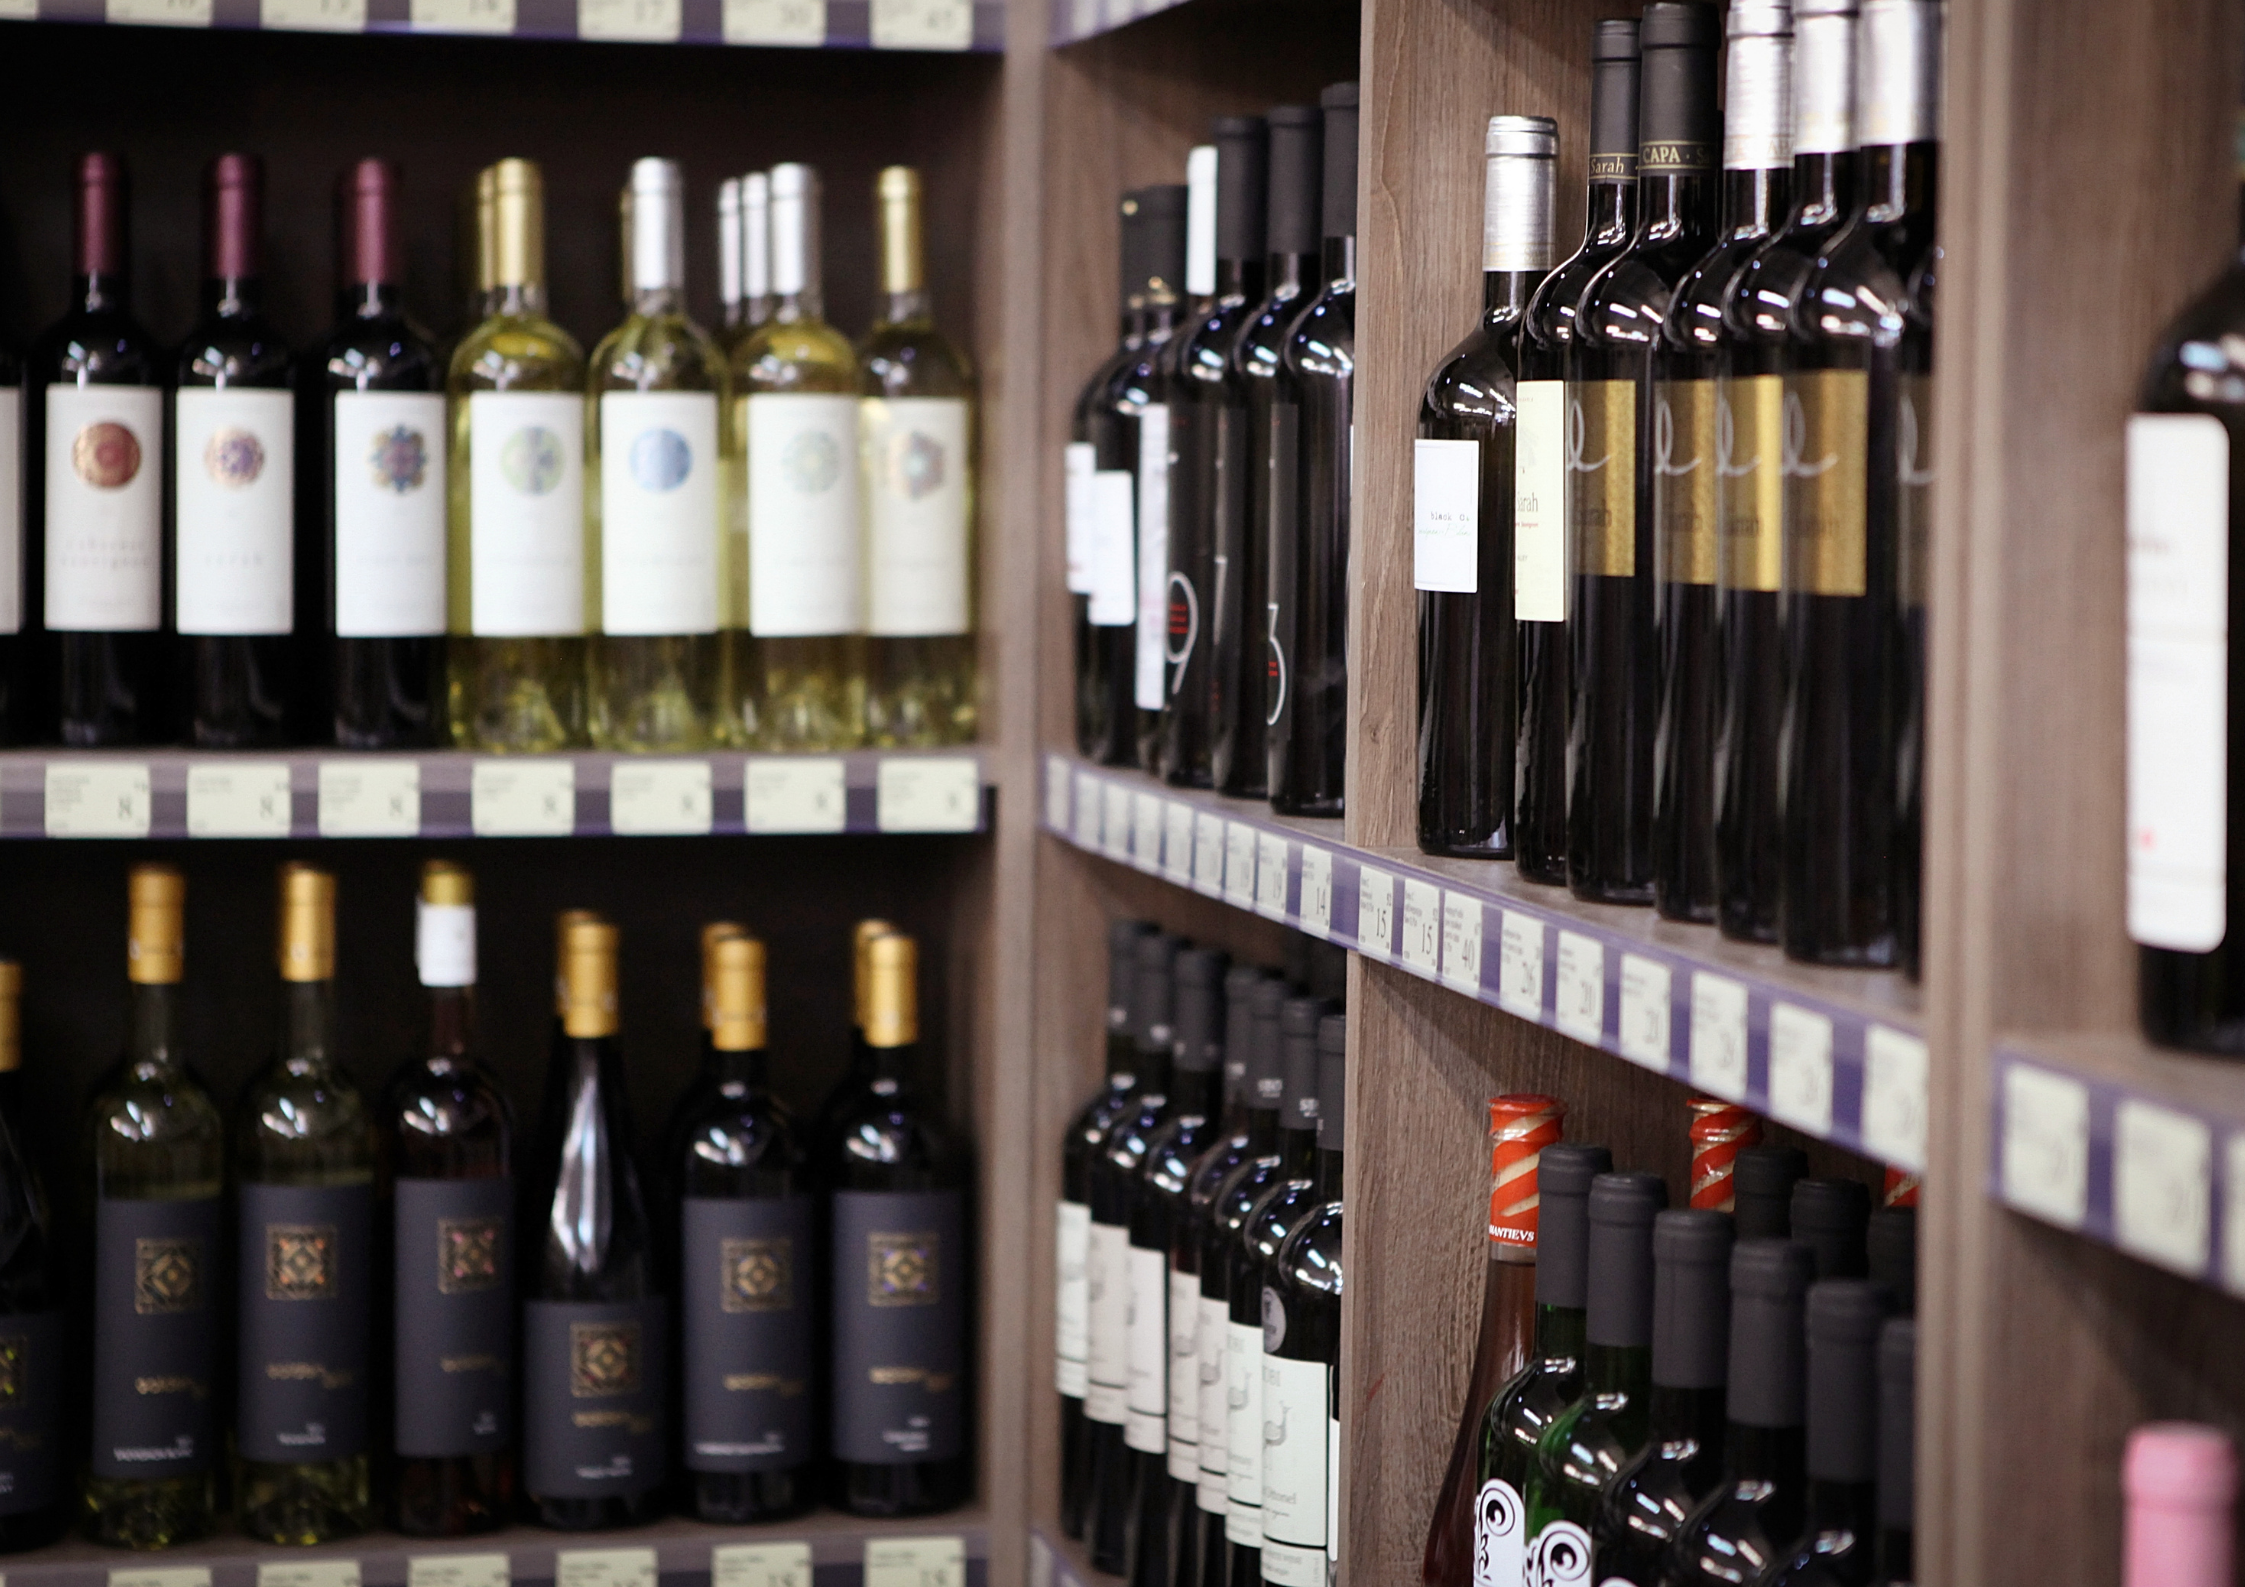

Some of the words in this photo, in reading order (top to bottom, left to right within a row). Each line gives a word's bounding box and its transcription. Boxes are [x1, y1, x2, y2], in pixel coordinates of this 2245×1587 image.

[1590, 157, 1624, 174] Sarah
[1430, 511, 1452, 521] black
[1376, 908, 1387, 939] 15
[1421, 923, 1433, 956] 15
[1462, 932, 1476, 971] 40
